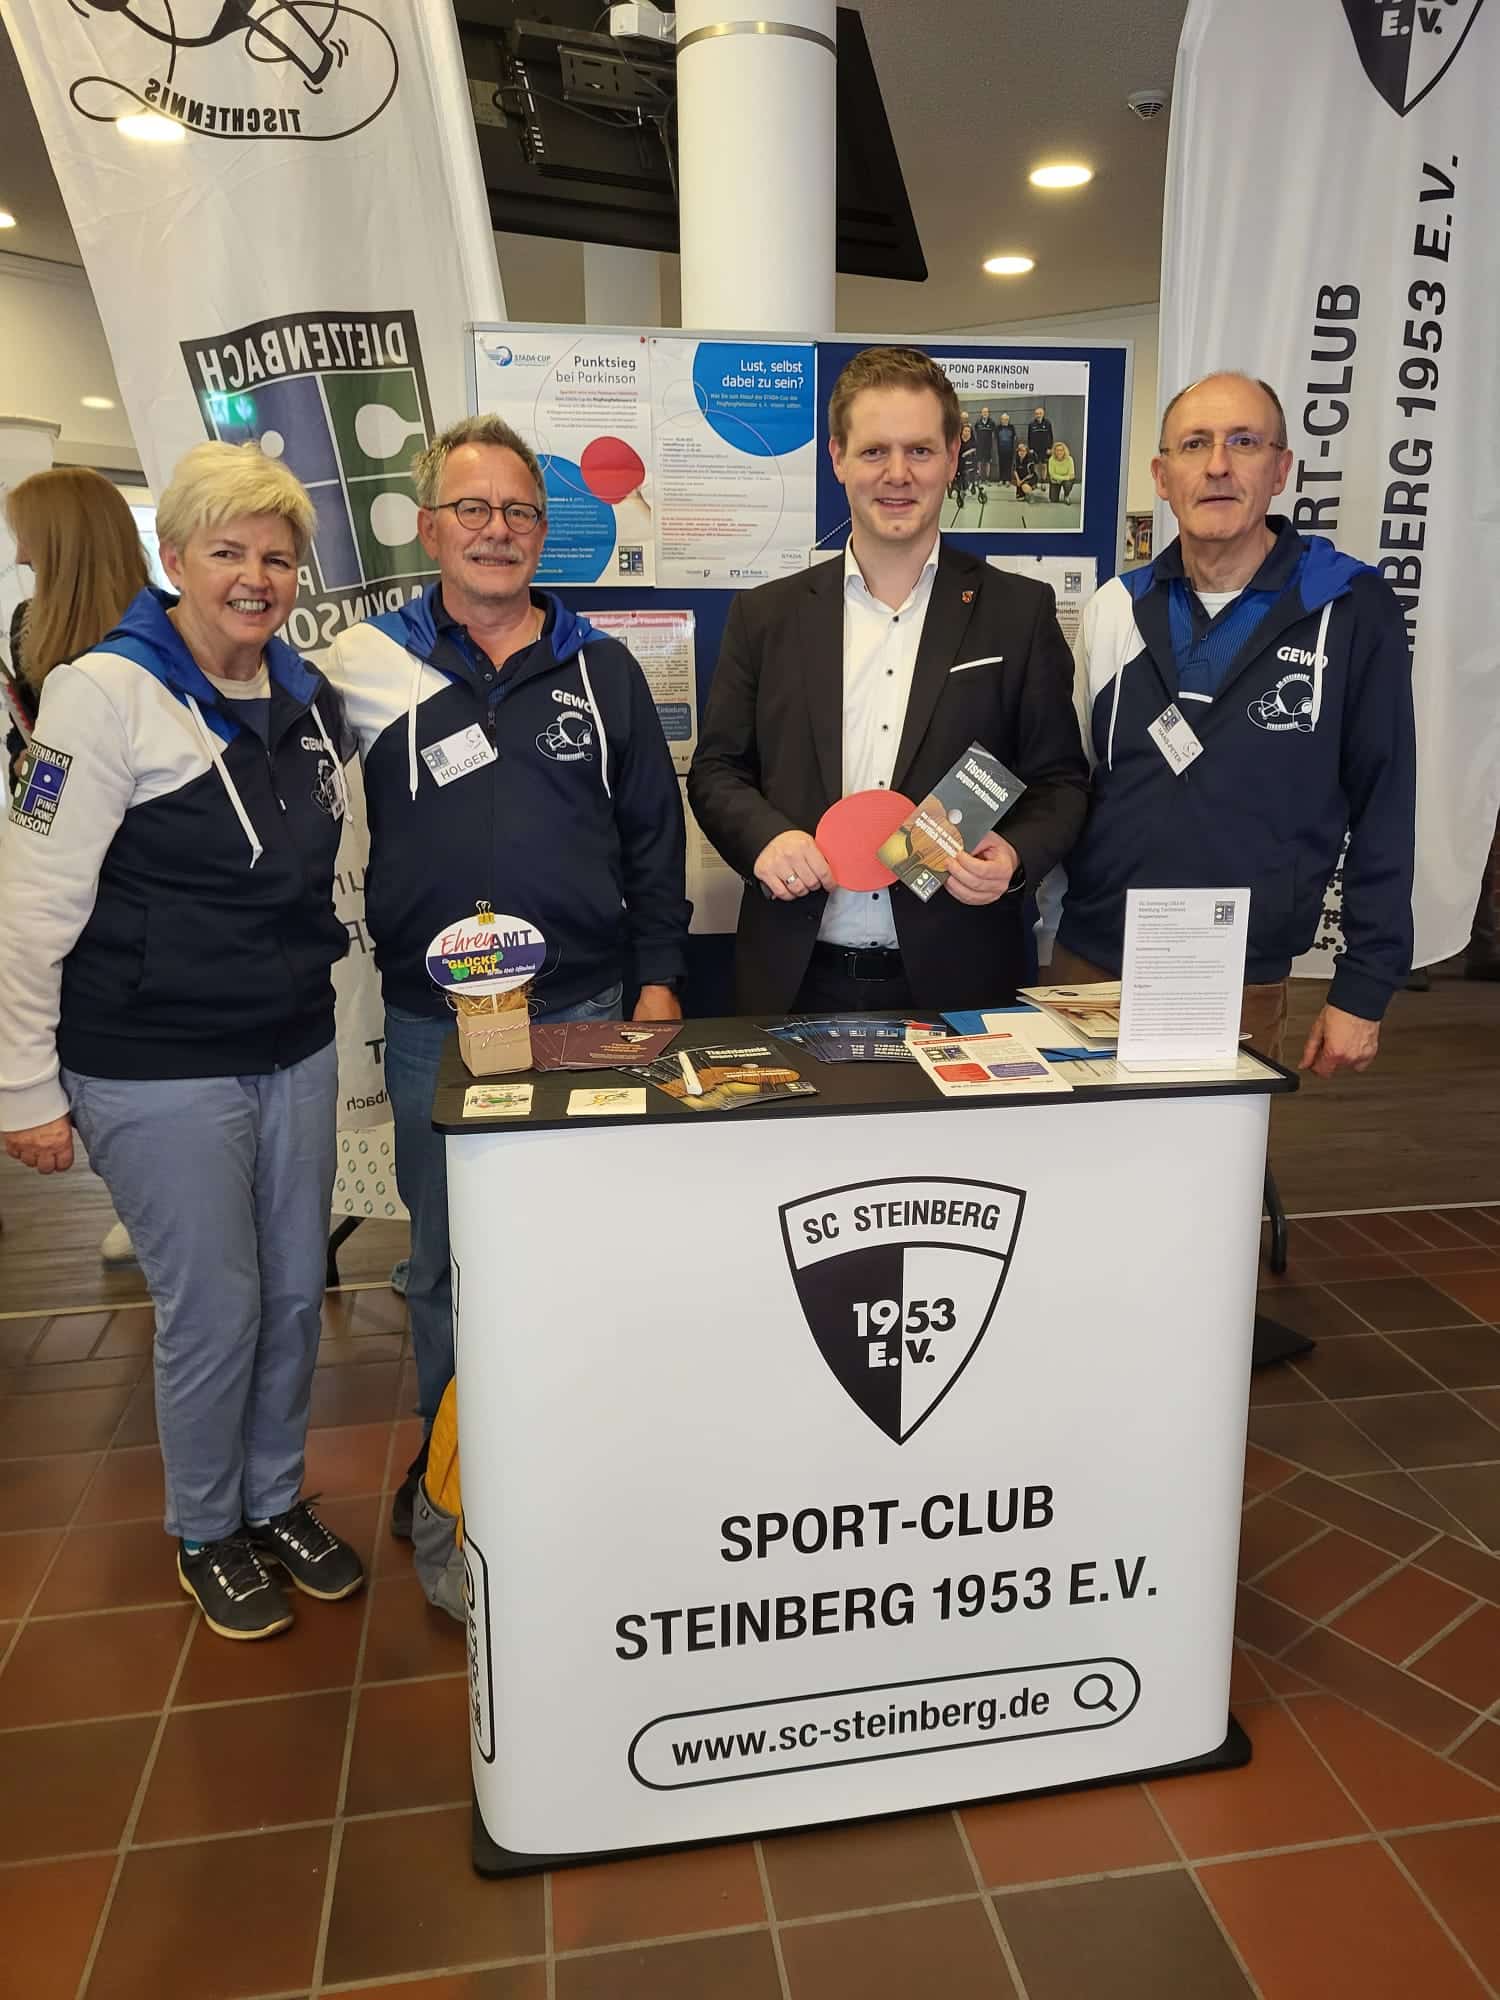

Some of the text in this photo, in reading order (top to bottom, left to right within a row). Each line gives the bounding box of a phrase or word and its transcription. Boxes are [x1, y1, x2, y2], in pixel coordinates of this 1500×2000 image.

[1414, 155, 1458, 263] E.V.
[1396, 280, 1446, 417] 1953
[574, 355, 636, 371] Punktsieg
[740, 359, 803, 374] Lust, selbst
[949, 364, 975, 374] PONG
[976, 364, 1030, 375] PARKINSON
[556, 371, 636, 384] bei Parkinson
[722, 375, 804, 390] dabei zu sein?
[976, 380, 989, 389] SC
[991, 380, 1035, 391] Steinberg
[1293, 284, 1361, 530] RT-CLUB
[301, 736, 332, 752] GEW
[440, 751, 489, 780] HOLGER
[964, 758, 1008, 802] Tischtennis
[34, 808, 54, 822] PONG
[37, 798, 57, 812] PING
[13, 812, 50, 835] KINSON
[470, 965, 497, 975] FALL
[803, 1199, 1001, 1244] SC STEINBERG
[852, 1297, 957, 1337] 1953
[719, 1484, 1054, 1563] SPORT-CLUB
[615, 1555, 1158, 1661] STEINBERG 1953 E.V.
[672, 1686, 1051, 1766] www.sc-steinberg.de
